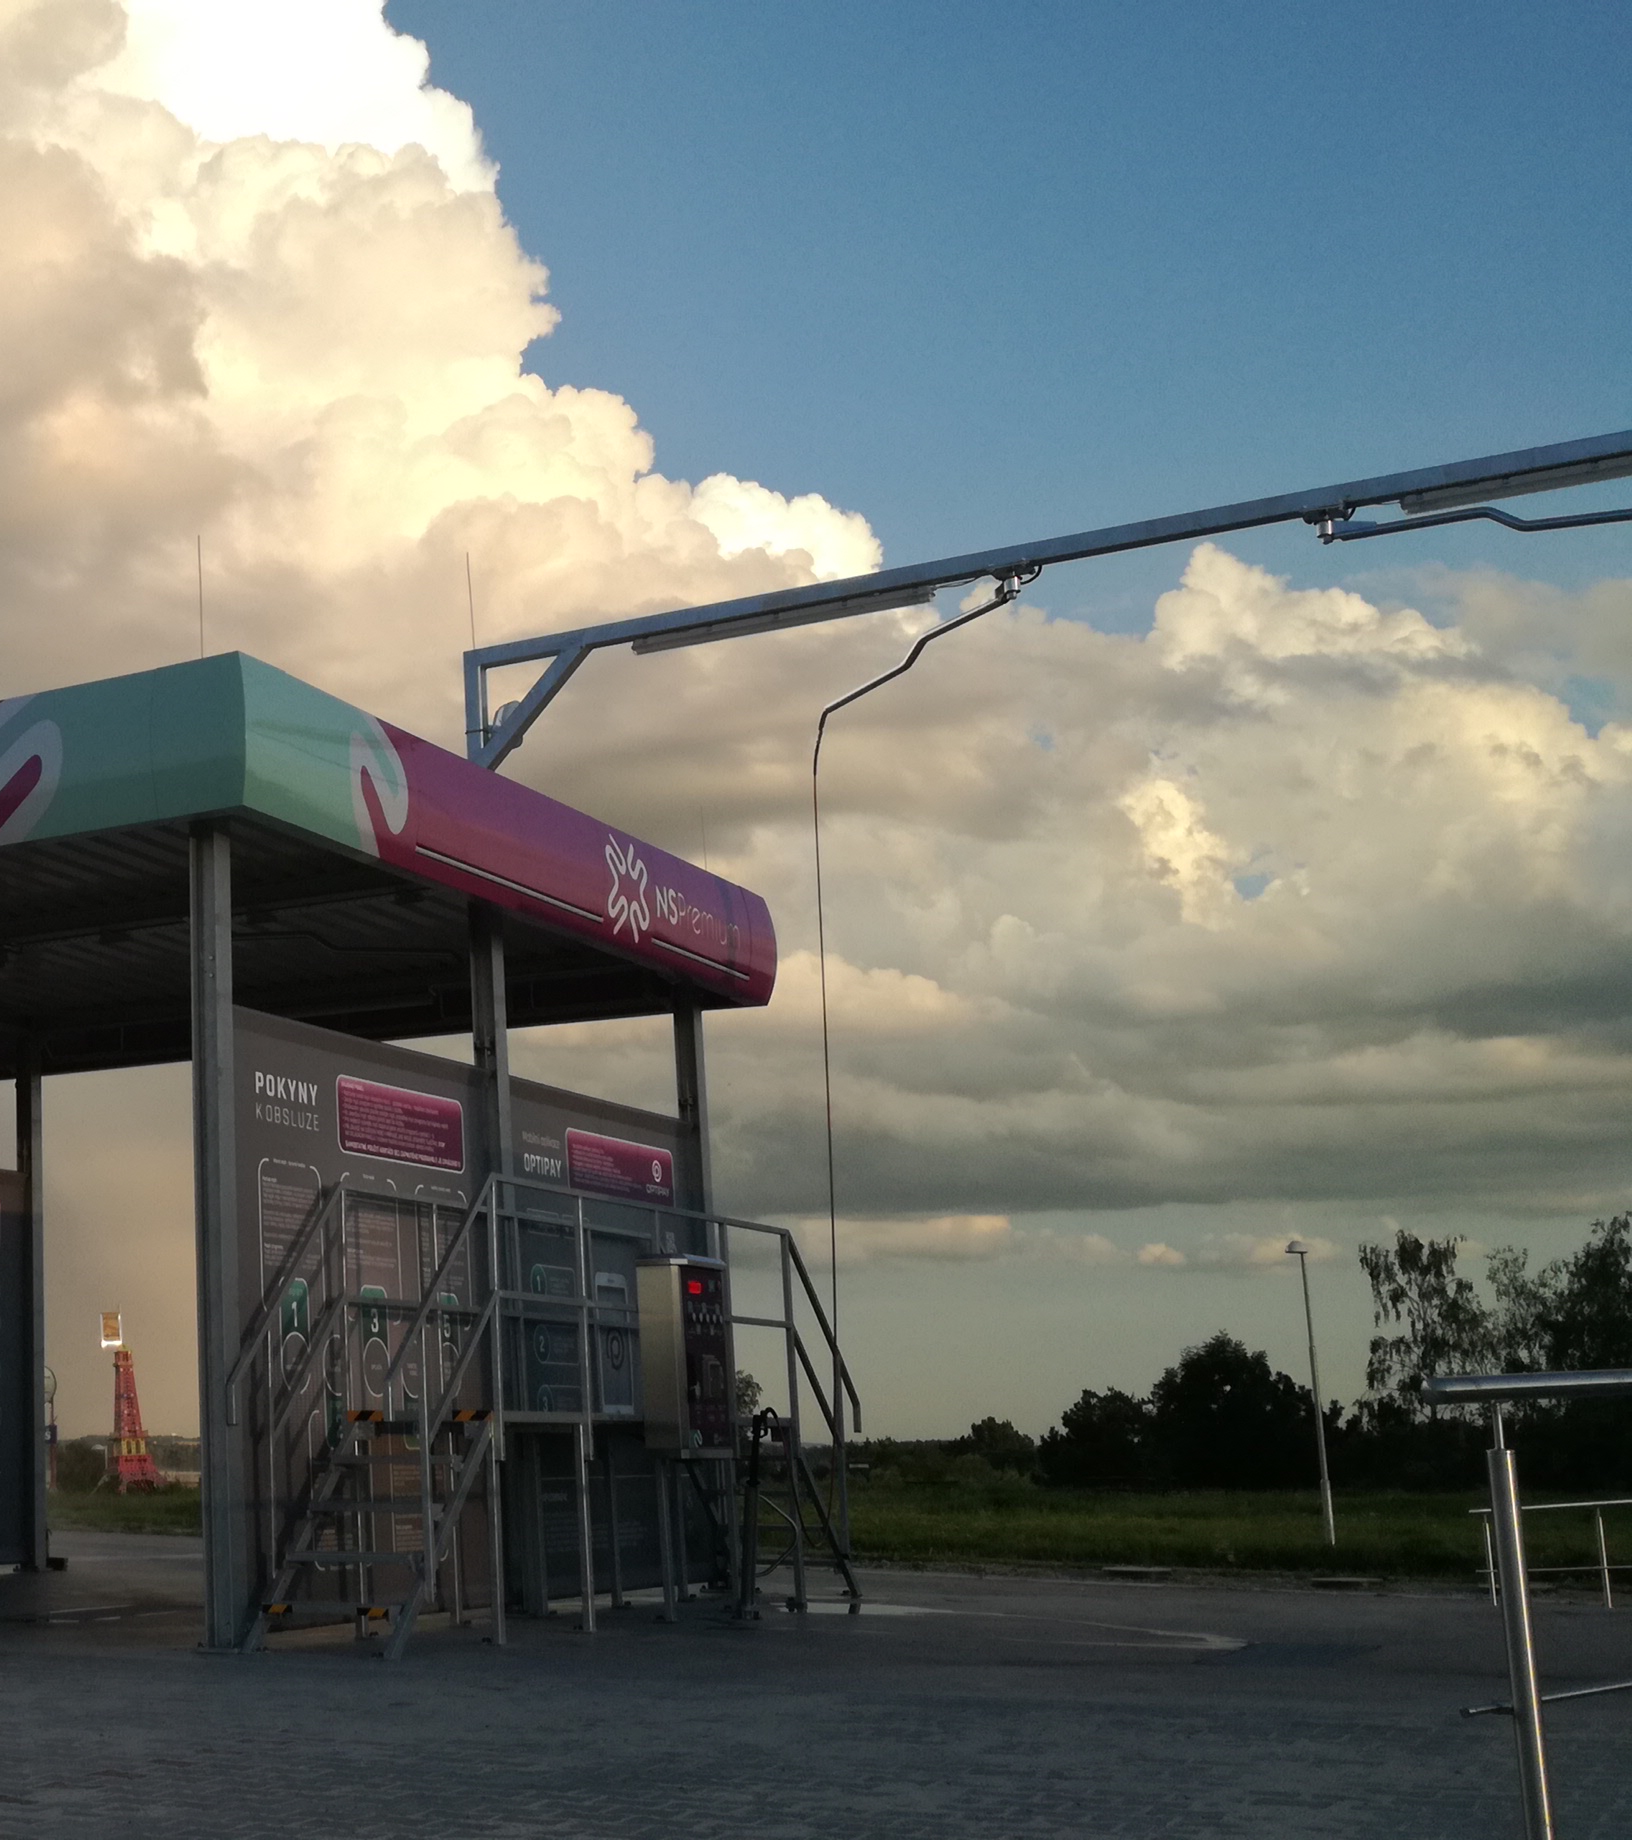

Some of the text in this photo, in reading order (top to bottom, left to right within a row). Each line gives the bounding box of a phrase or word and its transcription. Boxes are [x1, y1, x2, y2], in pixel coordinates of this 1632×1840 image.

[255, 1071, 318, 1106] POKYNY
[523, 1152, 562, 1179] OPTIPAY
[291, 1301, 298, 1327] 1
[370, 1308, 380, 1333] 3
